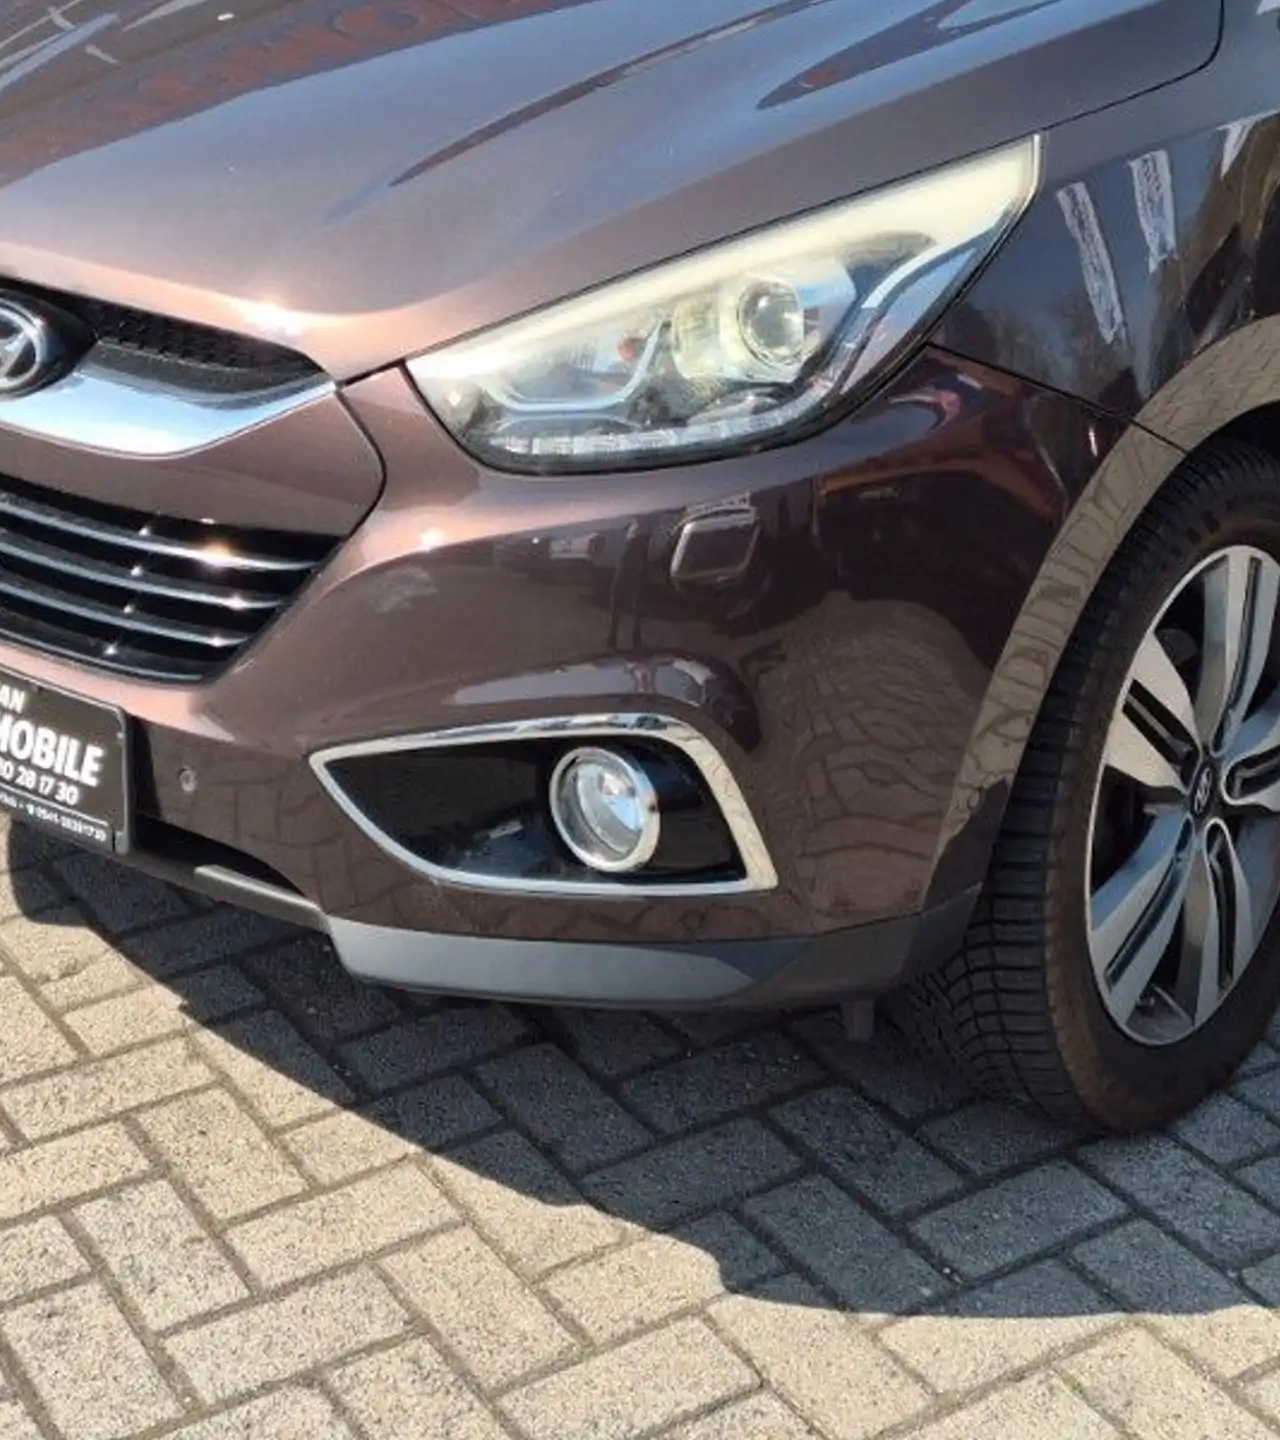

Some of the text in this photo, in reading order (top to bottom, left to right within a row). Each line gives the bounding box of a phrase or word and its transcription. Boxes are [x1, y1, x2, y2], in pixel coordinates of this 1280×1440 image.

[14, 765, 36, 790] 28
[38, 773, 54, 796] 17
[54, 781, 79, 806] 30
